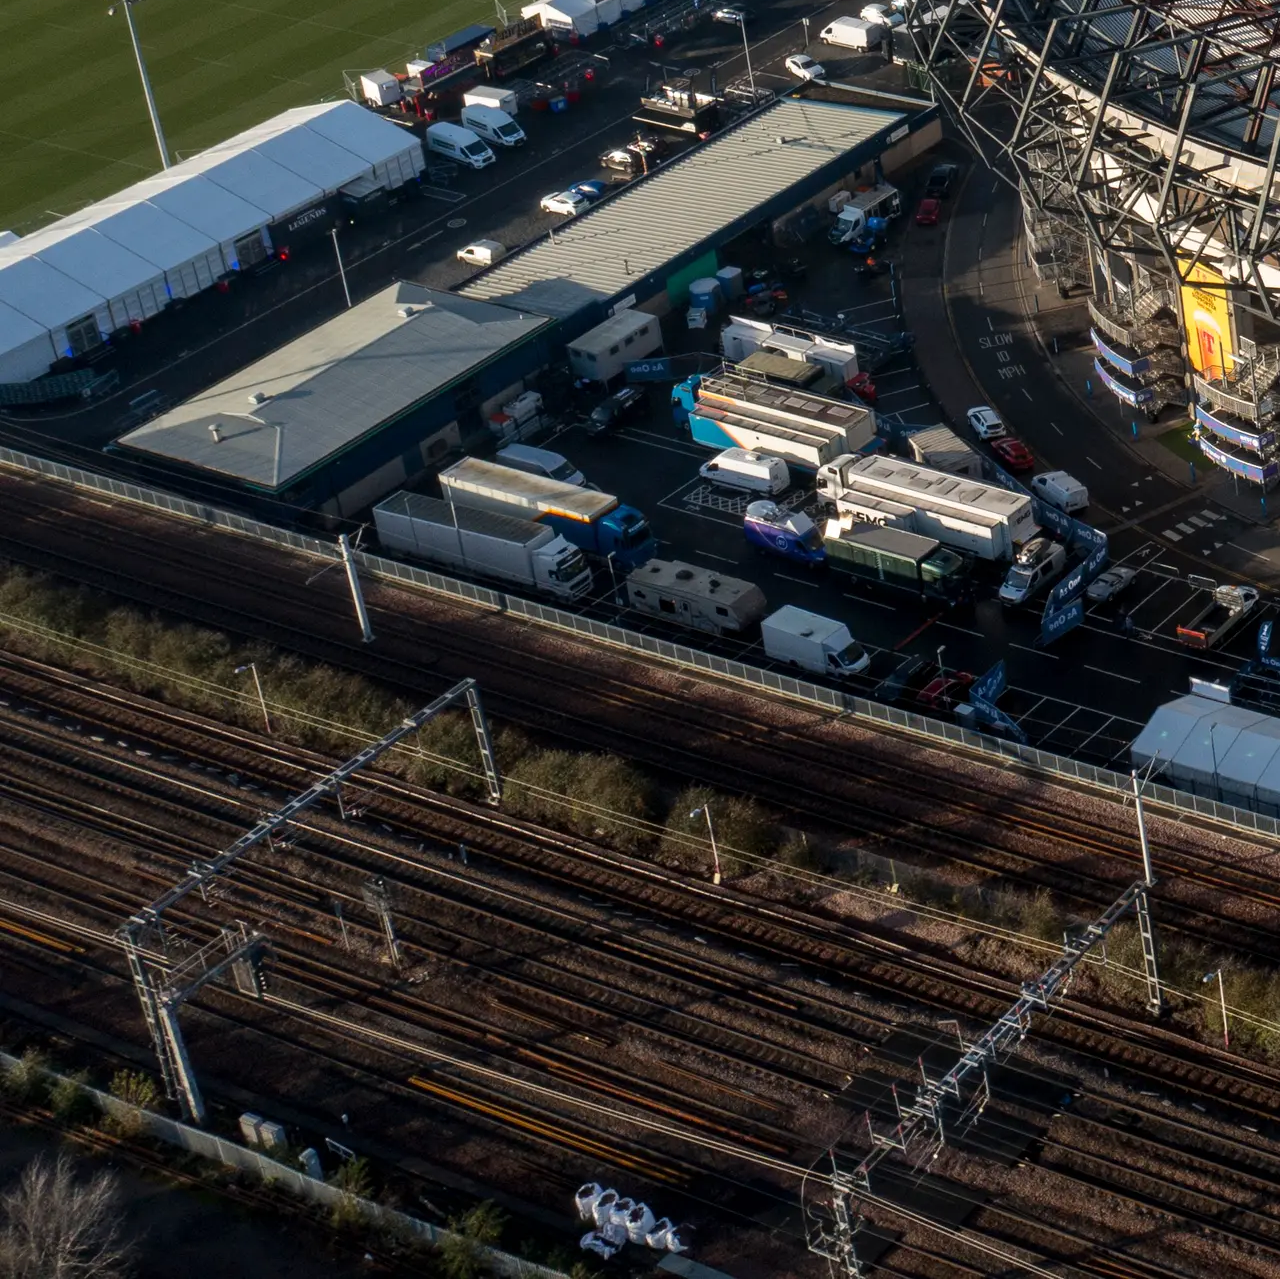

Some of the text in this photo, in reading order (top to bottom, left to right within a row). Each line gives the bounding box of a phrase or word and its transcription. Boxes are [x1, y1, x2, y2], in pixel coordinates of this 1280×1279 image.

[288, 206, 327, 231] LEGENDS
[979, 332, 1014, 349] SLOW
[996, 350, 1011, 363] 10
[997, 364, 1026, 380] MPH
[1059, 588, 1068, 600] As
[1260, 657, 1270, 665] As
